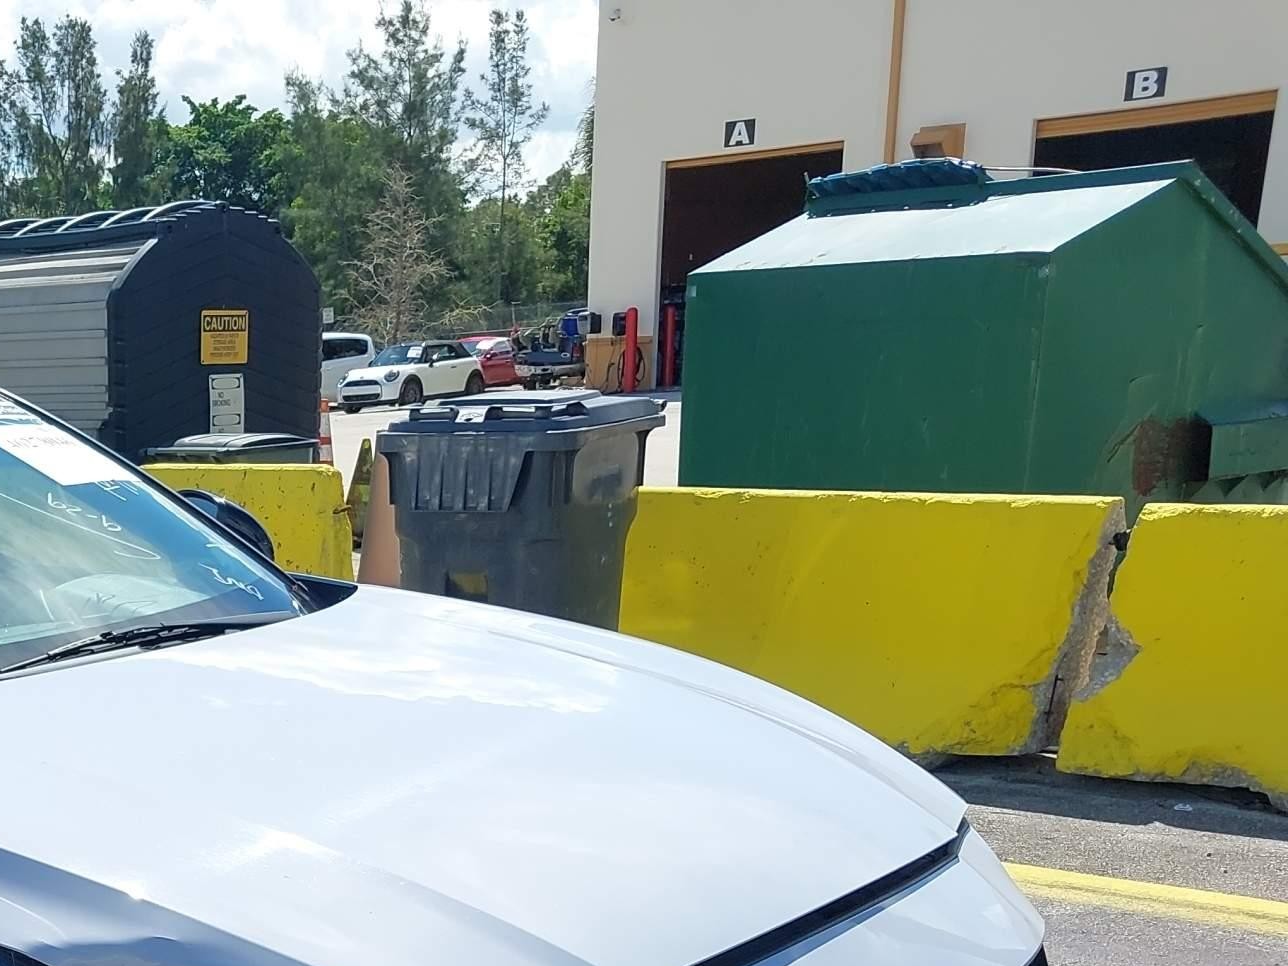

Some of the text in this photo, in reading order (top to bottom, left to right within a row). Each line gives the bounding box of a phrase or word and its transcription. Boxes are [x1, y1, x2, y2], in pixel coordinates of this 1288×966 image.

[1132, 70, 1158, 99] B
[728, 121, 751, 146] A
[204, 316, 246, 331] CAUTION
